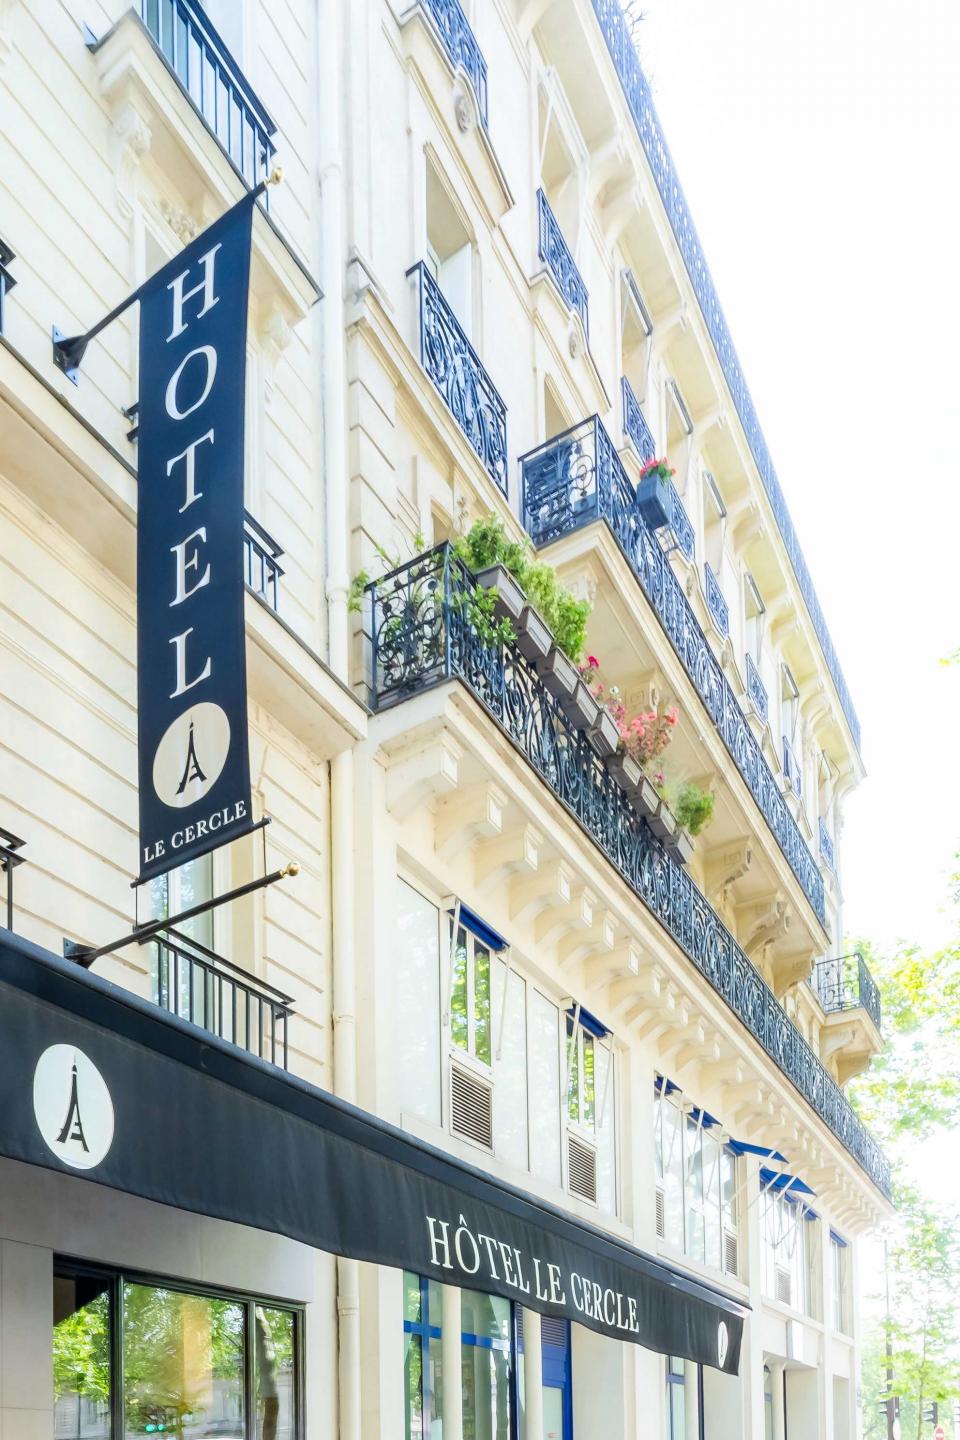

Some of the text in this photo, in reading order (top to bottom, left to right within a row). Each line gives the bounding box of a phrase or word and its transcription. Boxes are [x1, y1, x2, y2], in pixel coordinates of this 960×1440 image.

[165, 242, 222, 699] HOTEL
[143, 800, 247, 864] LE CERCLE
[426, 1213, 640, 1333] HÔTEL LE CERCLE
